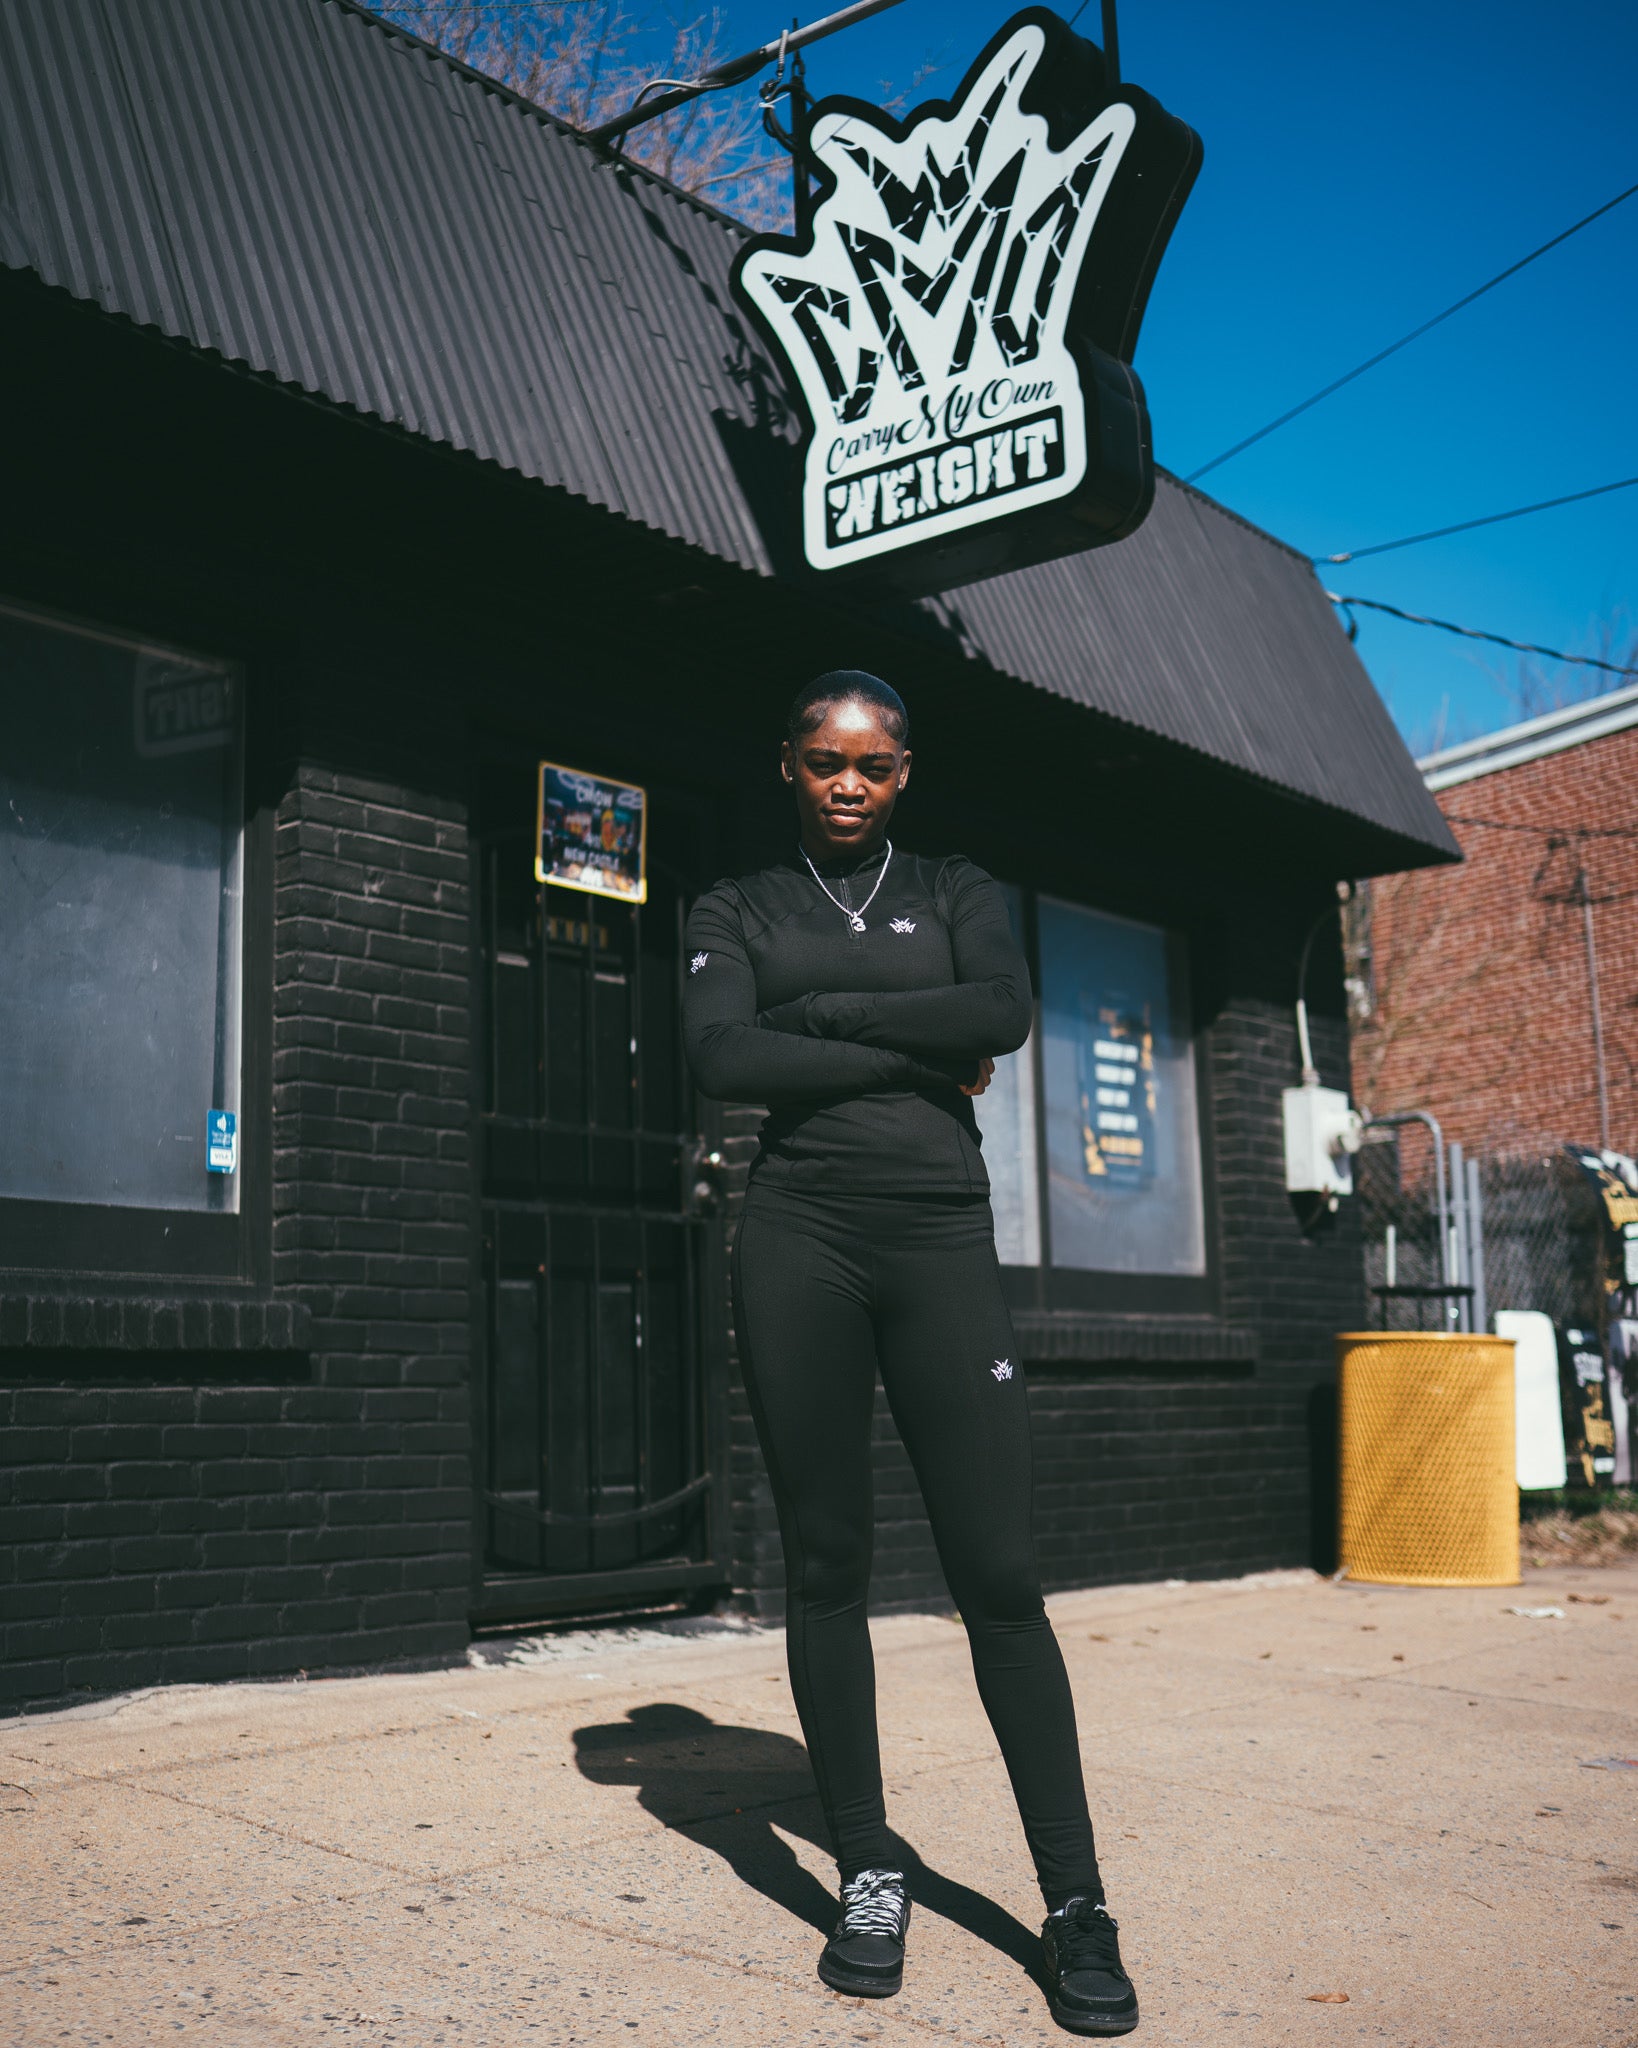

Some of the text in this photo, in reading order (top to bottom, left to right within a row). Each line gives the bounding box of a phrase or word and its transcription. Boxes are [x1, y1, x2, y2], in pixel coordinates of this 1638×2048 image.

[827, 378, 1058, 475] Carry My Own
[827, 418, 1058, 538] WEIGHT
[852, 917, 866, 932] 3
